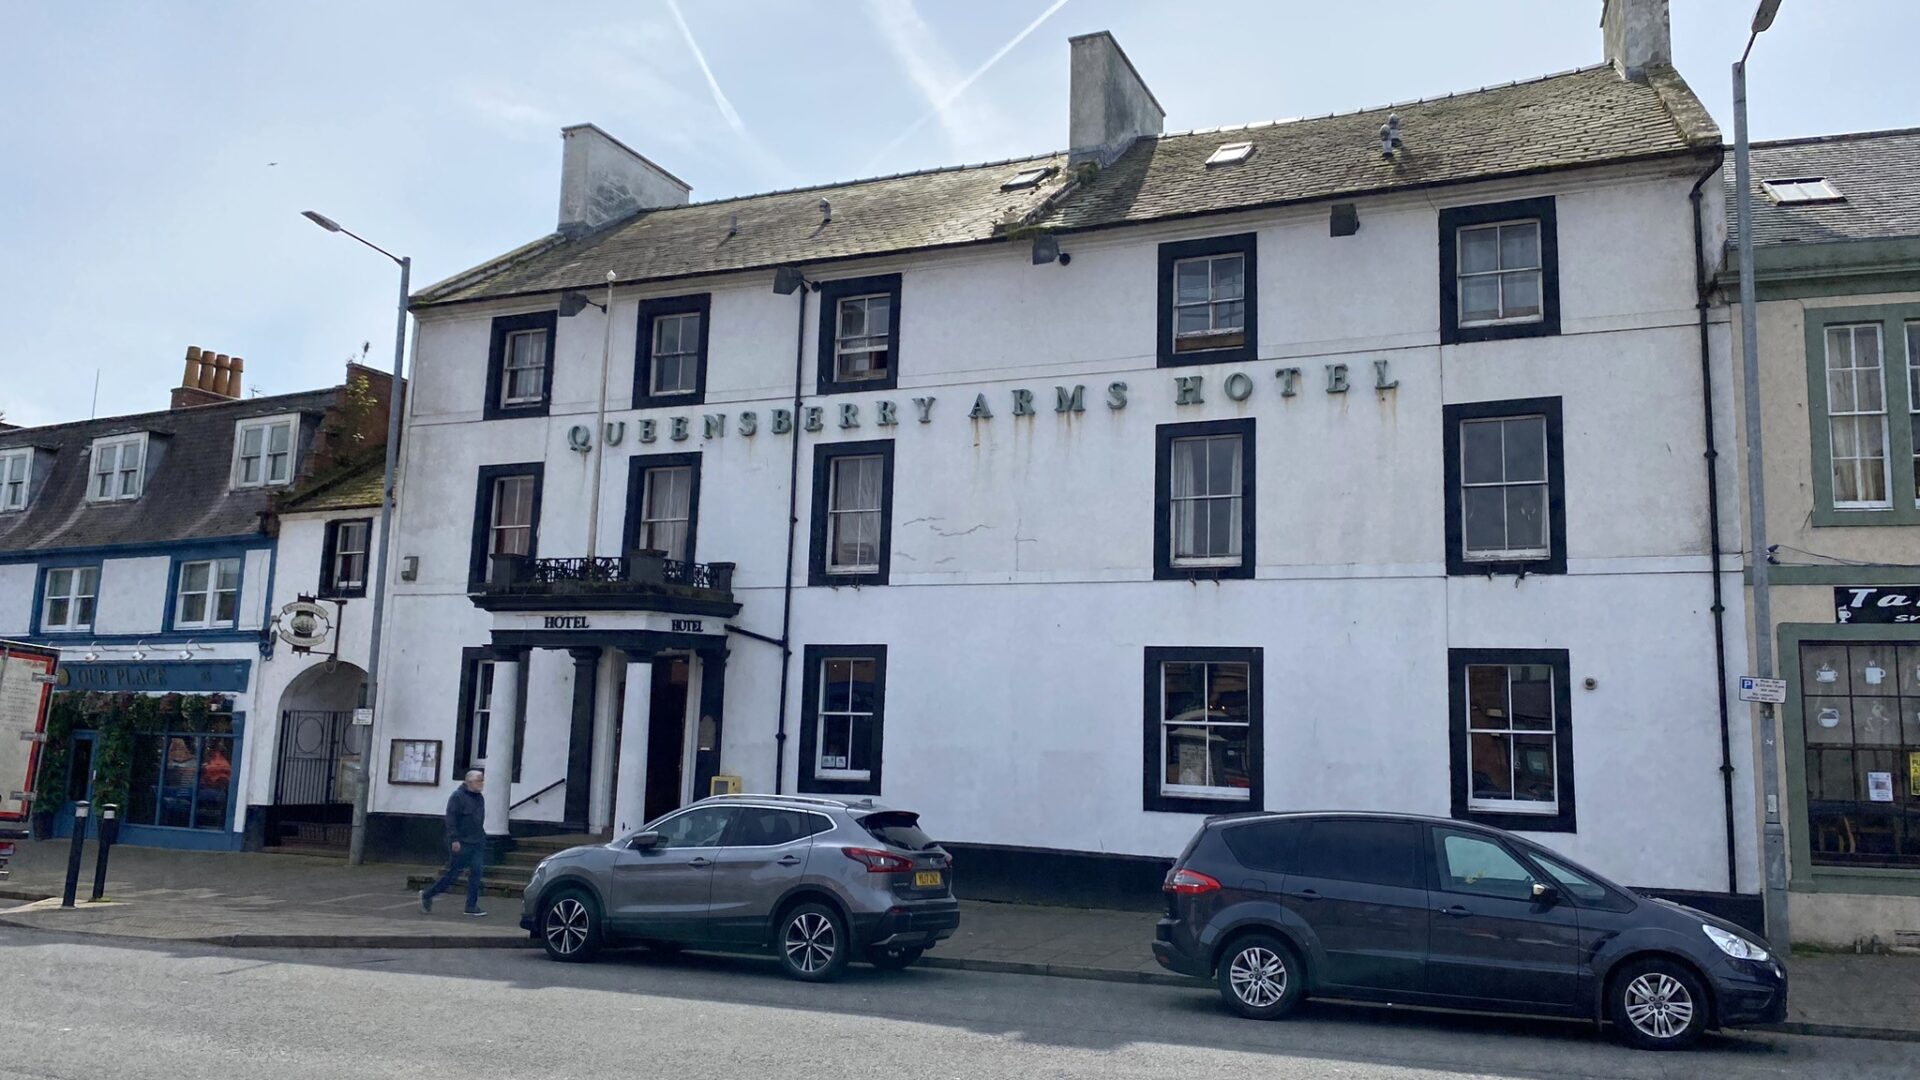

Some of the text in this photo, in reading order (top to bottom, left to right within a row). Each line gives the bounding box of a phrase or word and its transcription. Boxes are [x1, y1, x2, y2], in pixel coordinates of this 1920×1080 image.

[567, 359, 1399, 453] QUEENSBERRY ARMS HOTEL
[1848, 588, 1920, 608] Ta
[544, 616, 590, 629] HOTEL
[671, 619, 704, 633] HOTEL
[77, 666, 168, 686] OUR PLACE
